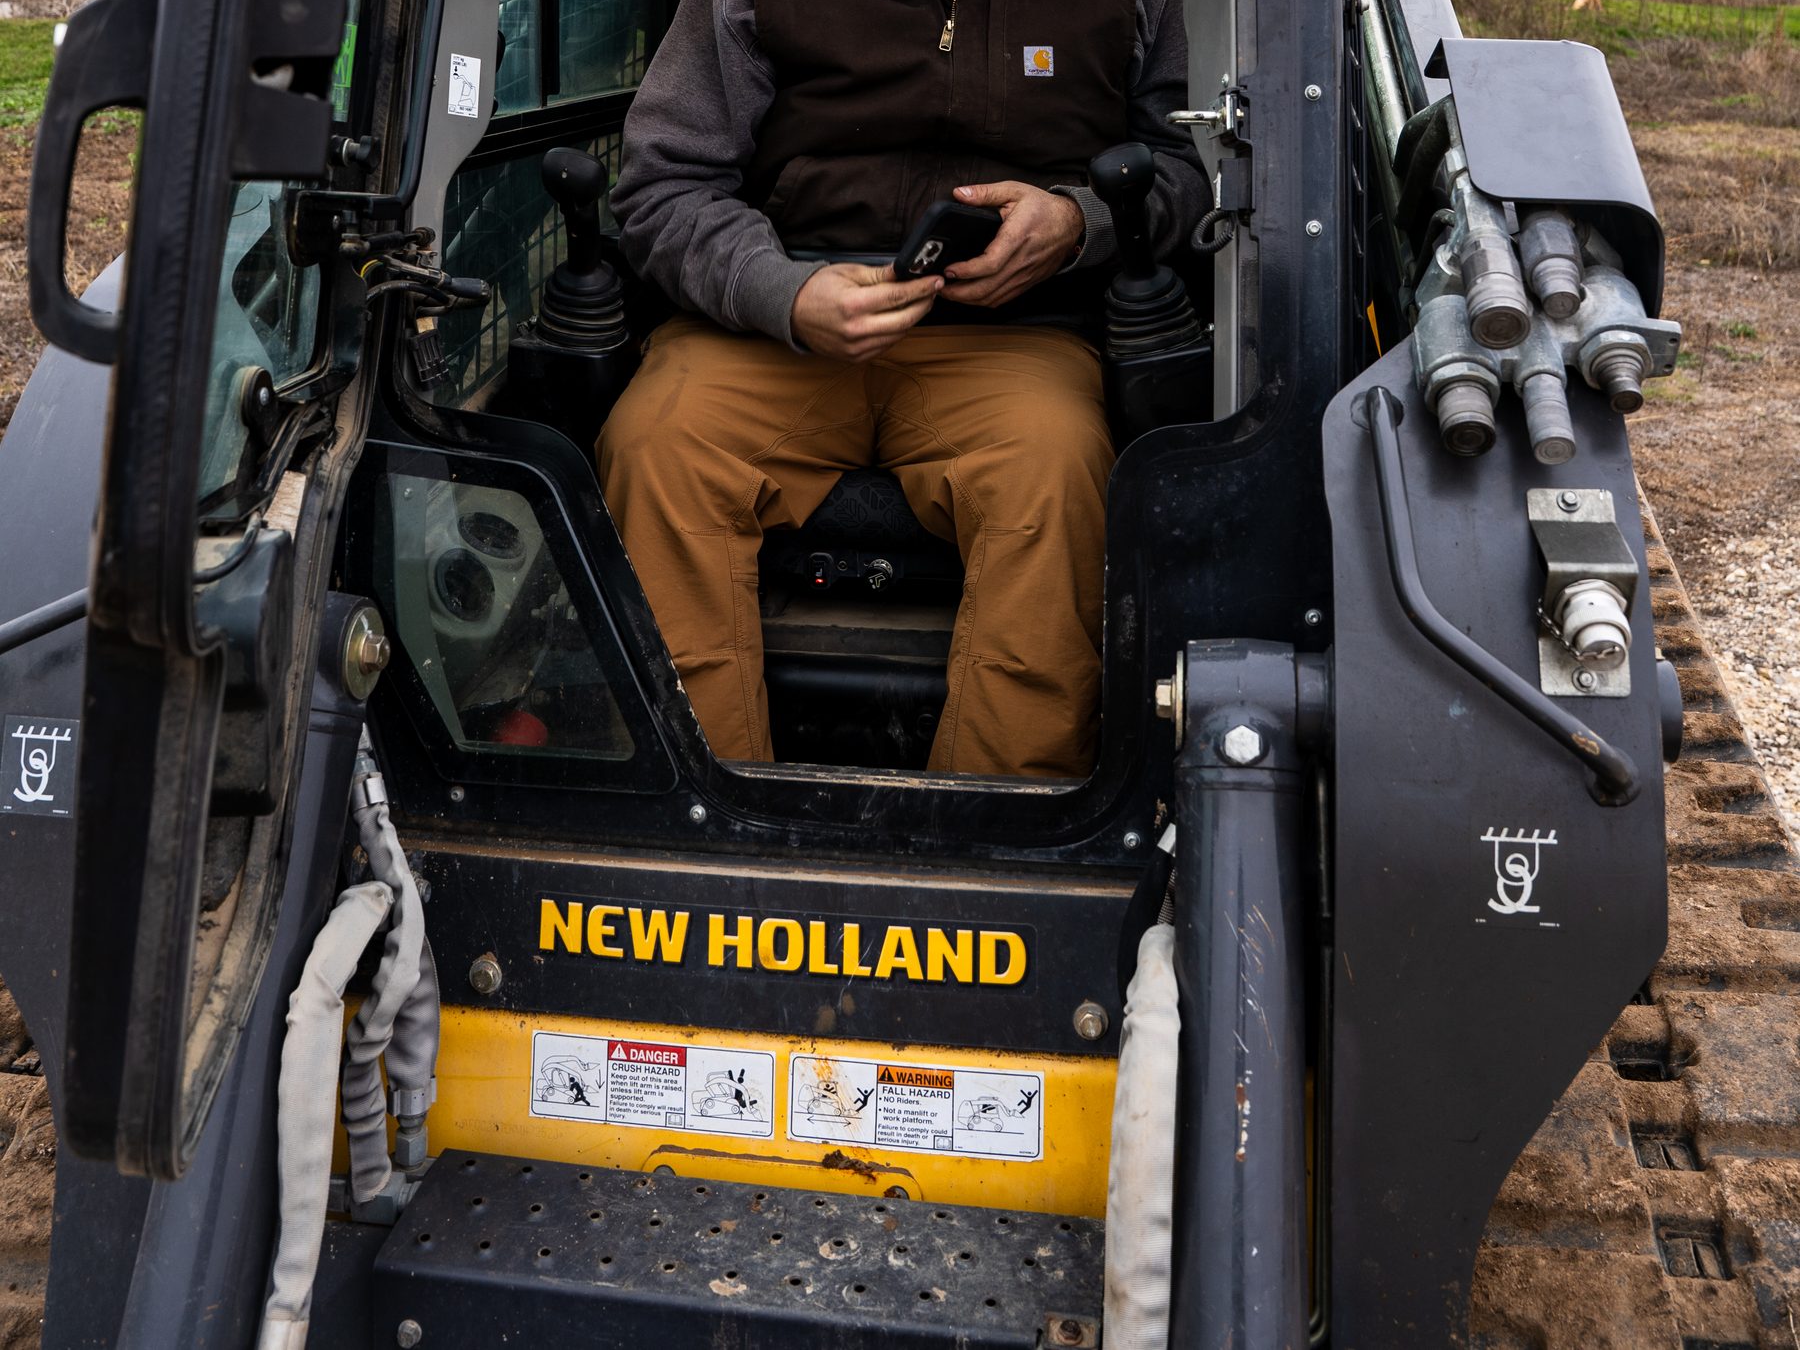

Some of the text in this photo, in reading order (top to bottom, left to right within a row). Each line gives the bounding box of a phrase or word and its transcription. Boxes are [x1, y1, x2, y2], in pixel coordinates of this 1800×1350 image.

[540, 898, 1027, 985] NEW HOLLAND
[630, 1049, 678, 1064] DANGER
[612, 1063, 680, 1076] CRUSH HAZARD
[896, 1072, 952, 1086] WARNING
[610, 1094, 645, 1102] supported.
[882, 1086, 950, 1099] FALL HAZARD
